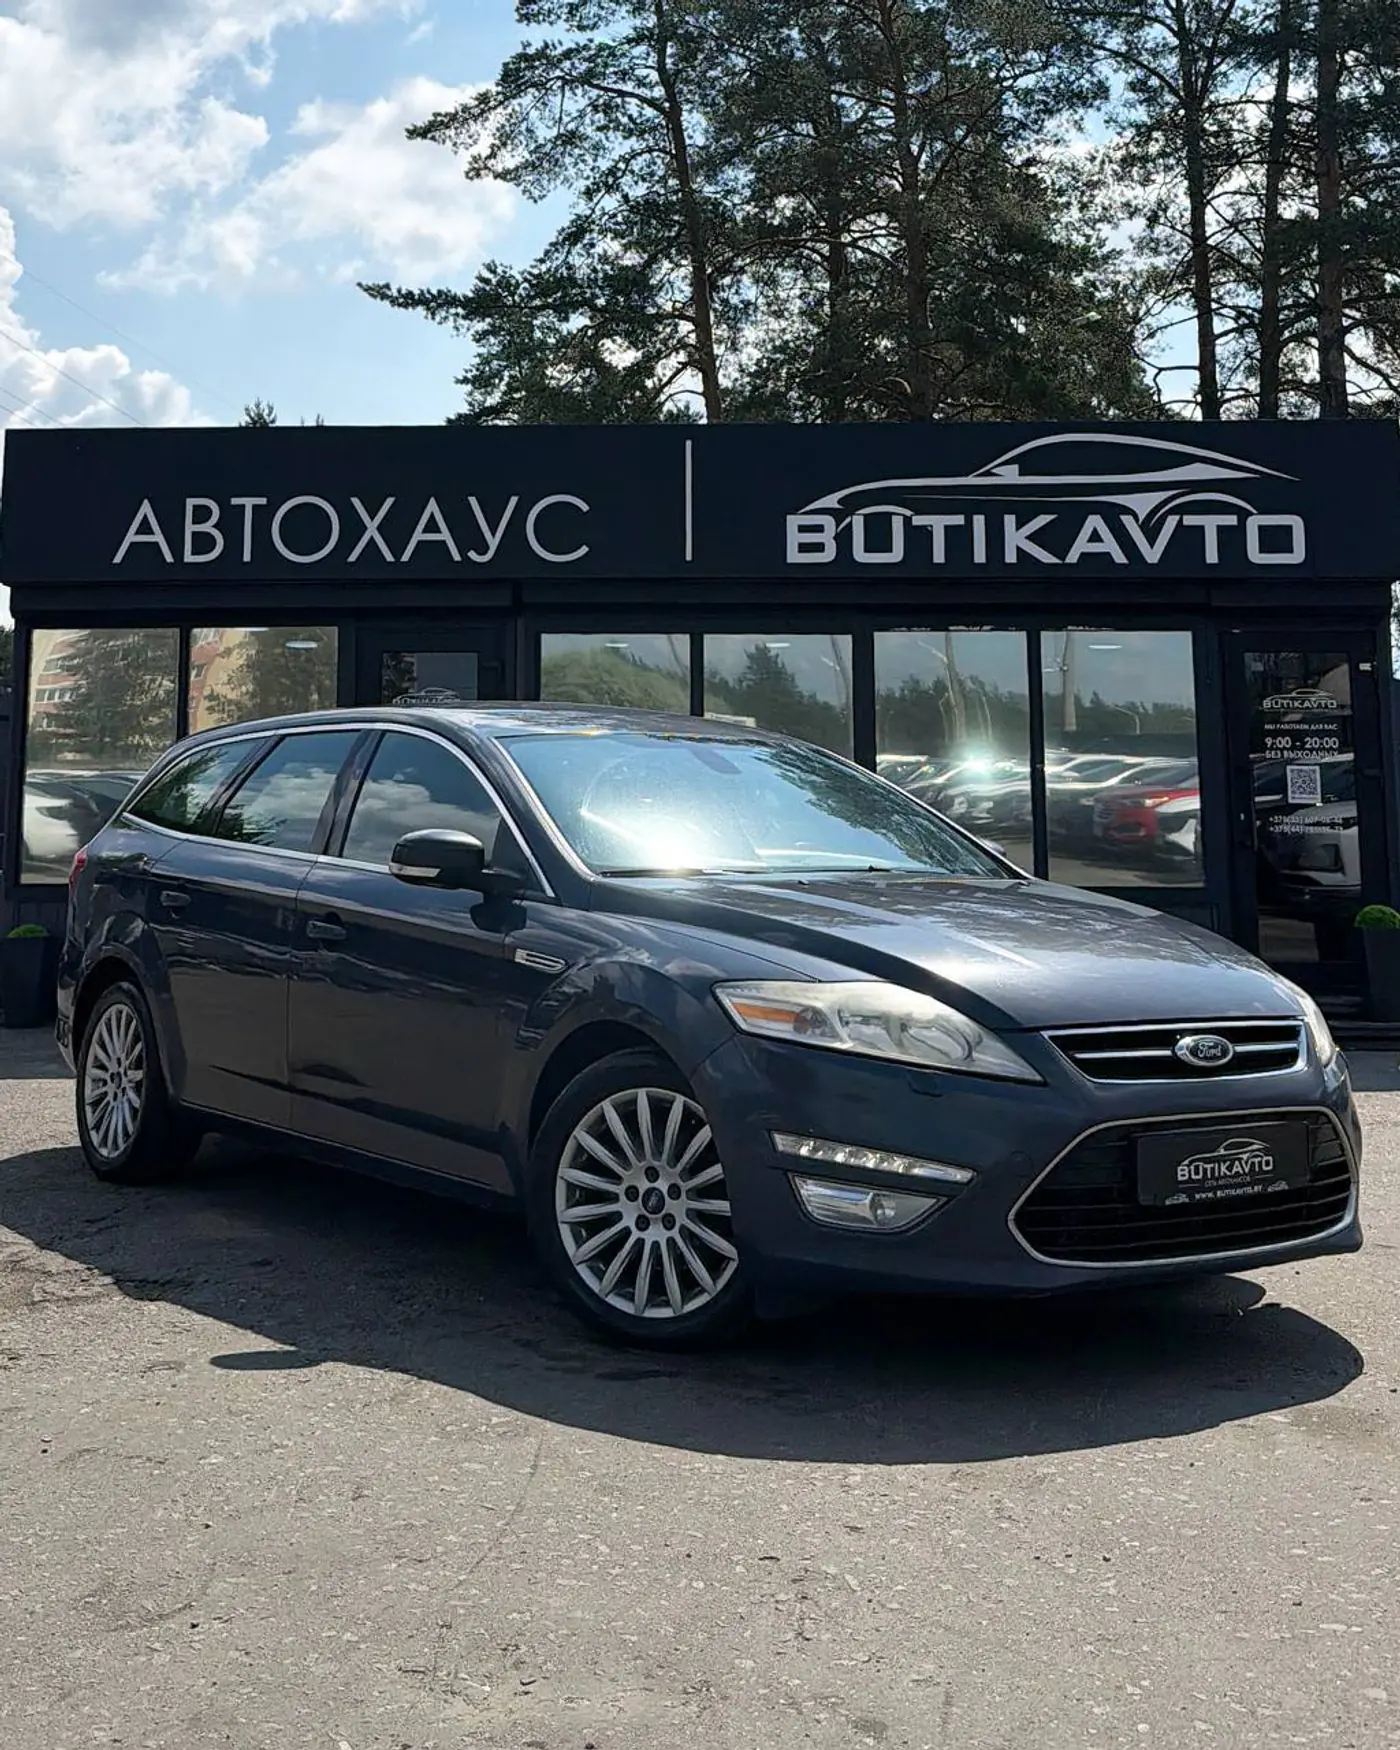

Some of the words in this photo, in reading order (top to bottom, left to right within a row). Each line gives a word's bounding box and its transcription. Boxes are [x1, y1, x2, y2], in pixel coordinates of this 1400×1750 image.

[112, 494, 590, 564] АВТОХАУС
[786, 513, 1306, 565] BUTIKAVTO
[1263, 699, 1337, 708] BUTIKAVTO
[1265, 736, 1292, 748] 9:00
[1304, 736, 1339, 748] 20:00
[1265, 750, 1281, 759] БЕЗ
[1283, 750, 1338, 760] ВЫХОДНЫХ
[1198, 1042, 1221, 1058] Ford
[1177, 1156, 1273, 1181] BUTIKAVTO
